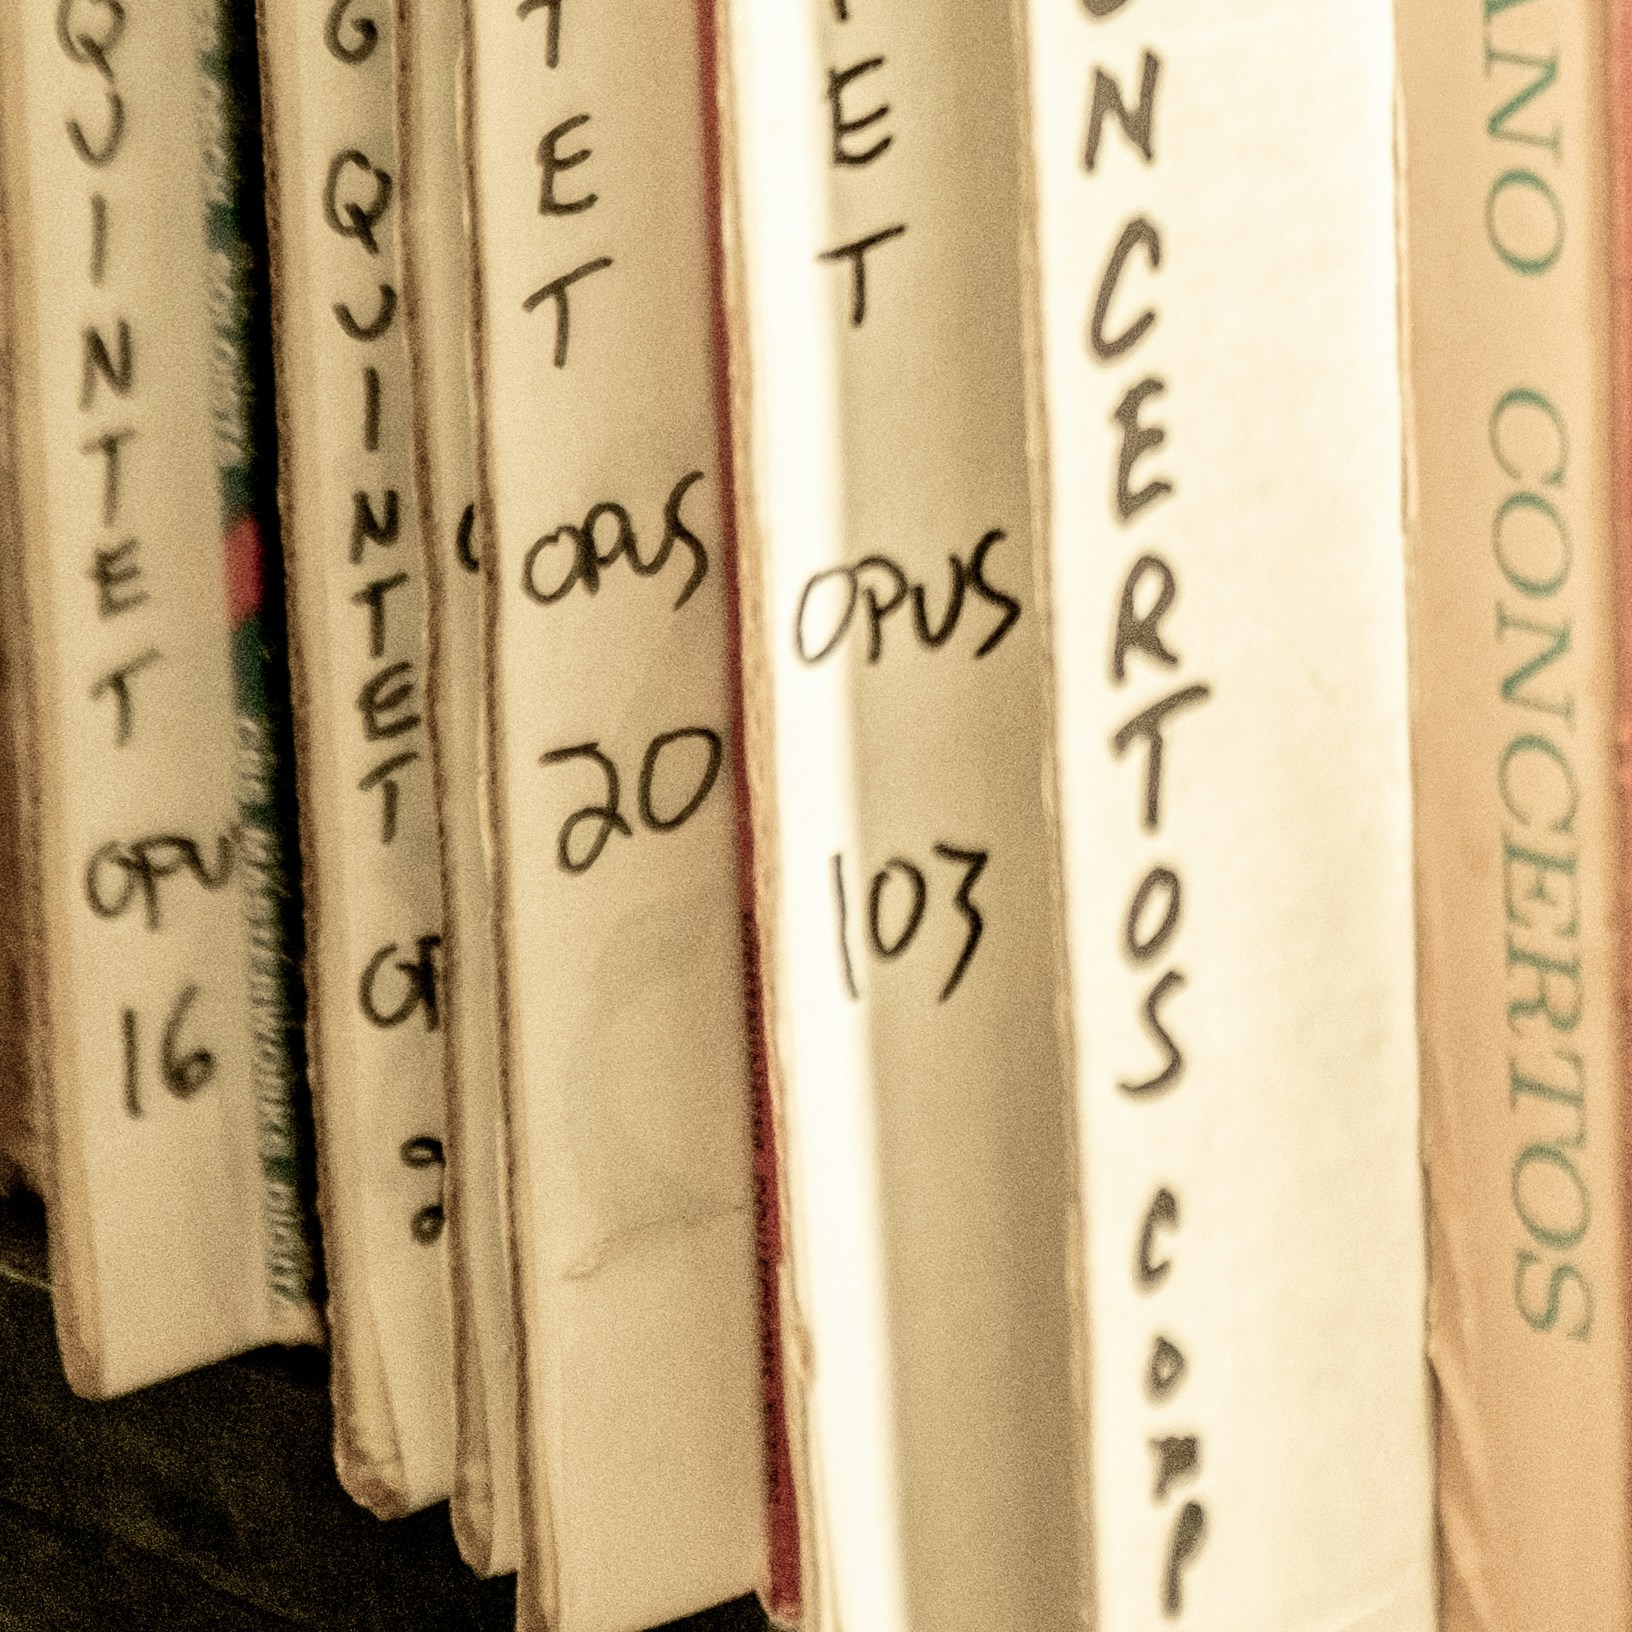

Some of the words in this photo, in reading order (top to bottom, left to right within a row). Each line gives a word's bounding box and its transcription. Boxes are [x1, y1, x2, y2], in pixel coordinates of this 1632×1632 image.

[323, 148, 421, 846] QUINTET
[793, 526, 1023, 666] OPUS
[540, 723, 727, 877] 20
[1484, 385, 1596, 1345] CONCERTOS
[86, 832, 246, 930] OPU
[830, 838, 990, 1005] 103
[122, 986, 218, 1119] 16
